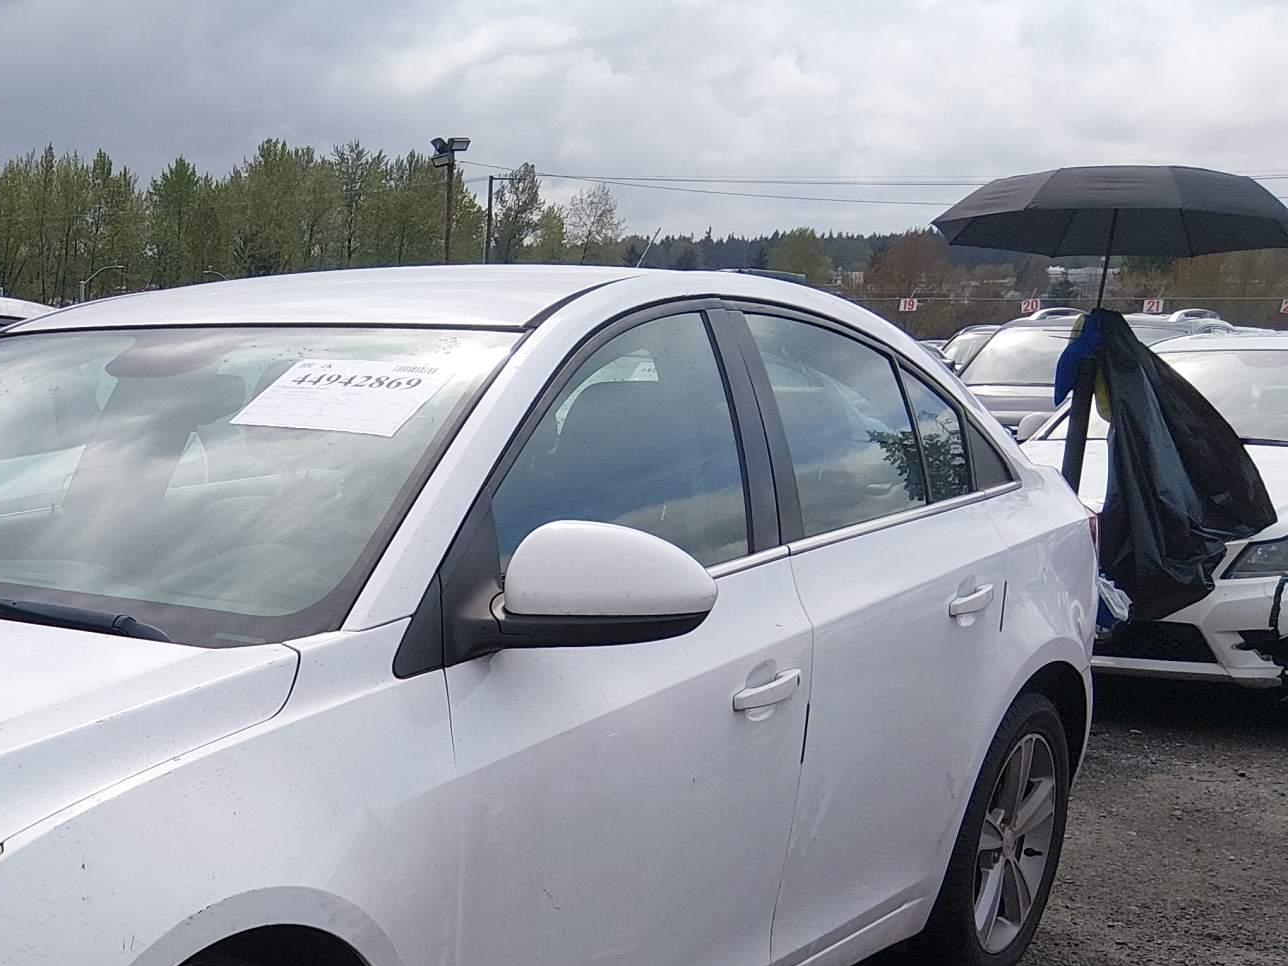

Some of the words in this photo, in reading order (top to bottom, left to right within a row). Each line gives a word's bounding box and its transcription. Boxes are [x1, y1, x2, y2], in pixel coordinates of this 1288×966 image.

[903, 300, 915, 311] 19
[1023, 300, 1038, 312] 20
[1146, 301, 1160, 312] 21
[292, 373, 422, 391] 44942869
